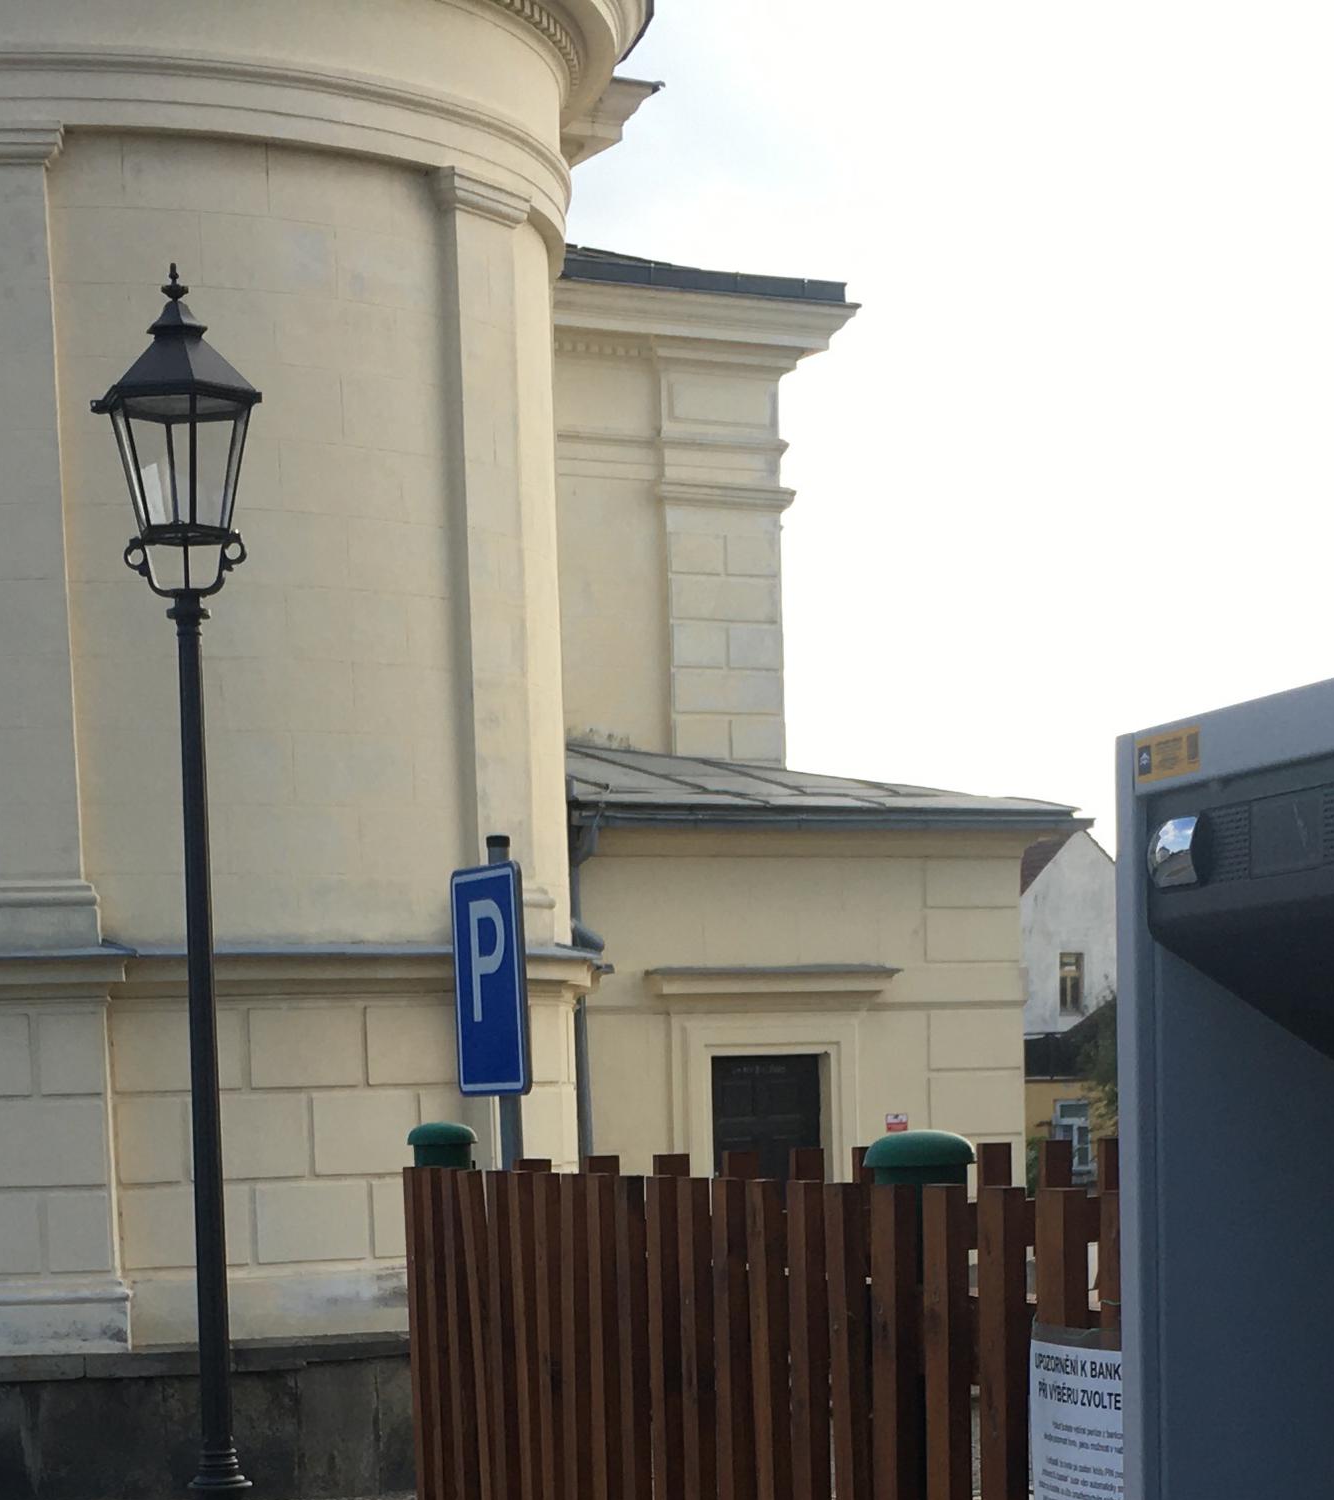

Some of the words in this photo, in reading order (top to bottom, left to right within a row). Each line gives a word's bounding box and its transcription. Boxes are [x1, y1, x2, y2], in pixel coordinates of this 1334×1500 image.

[468, 898, 505, 1022] P
[1080, 1359, 1087, 1378] K
[1080, 1389, 1122, 1411] ZVOLTE
